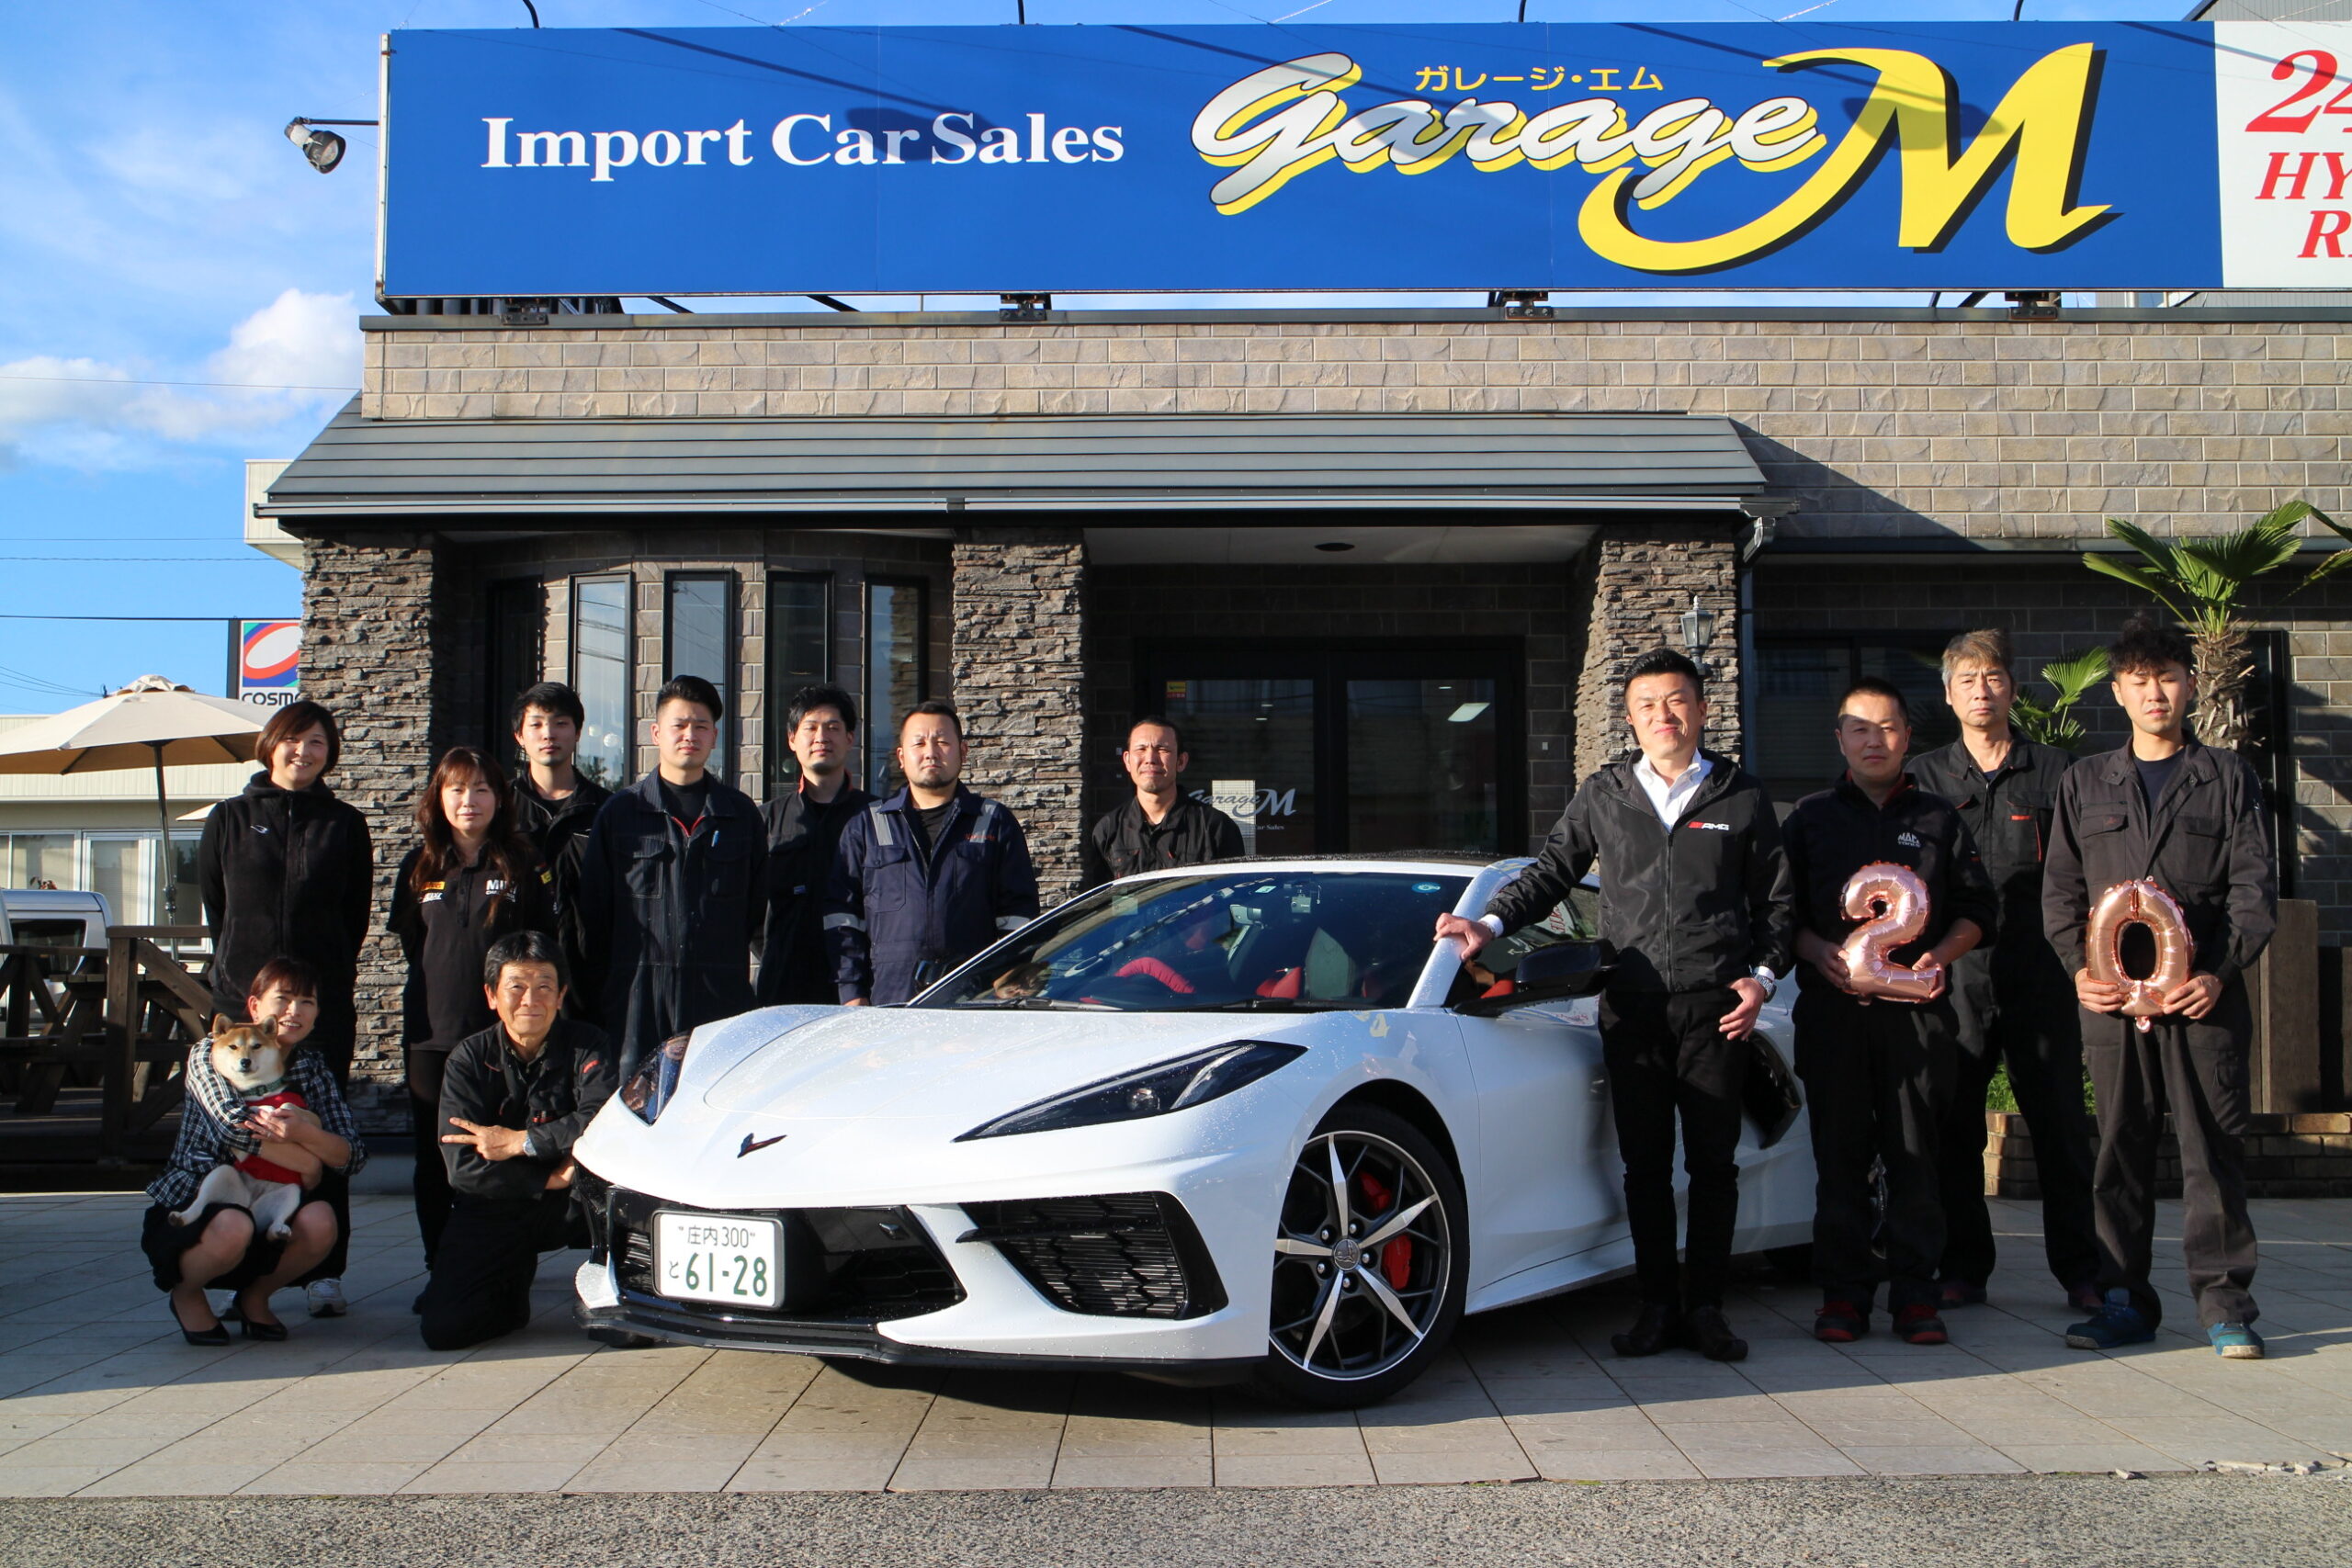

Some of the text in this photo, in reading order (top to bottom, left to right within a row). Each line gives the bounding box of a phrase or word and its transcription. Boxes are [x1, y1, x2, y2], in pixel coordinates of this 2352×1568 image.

[1414, 65, 1665, 92] ガレージ・エム
[481, 112, 1125, 183] Import Car Sales
[1192, 41, 2116, 271] Garage M
[1702, 822, 1730, 830] AMG
[685, 1251, 768, 1298] 61-28
